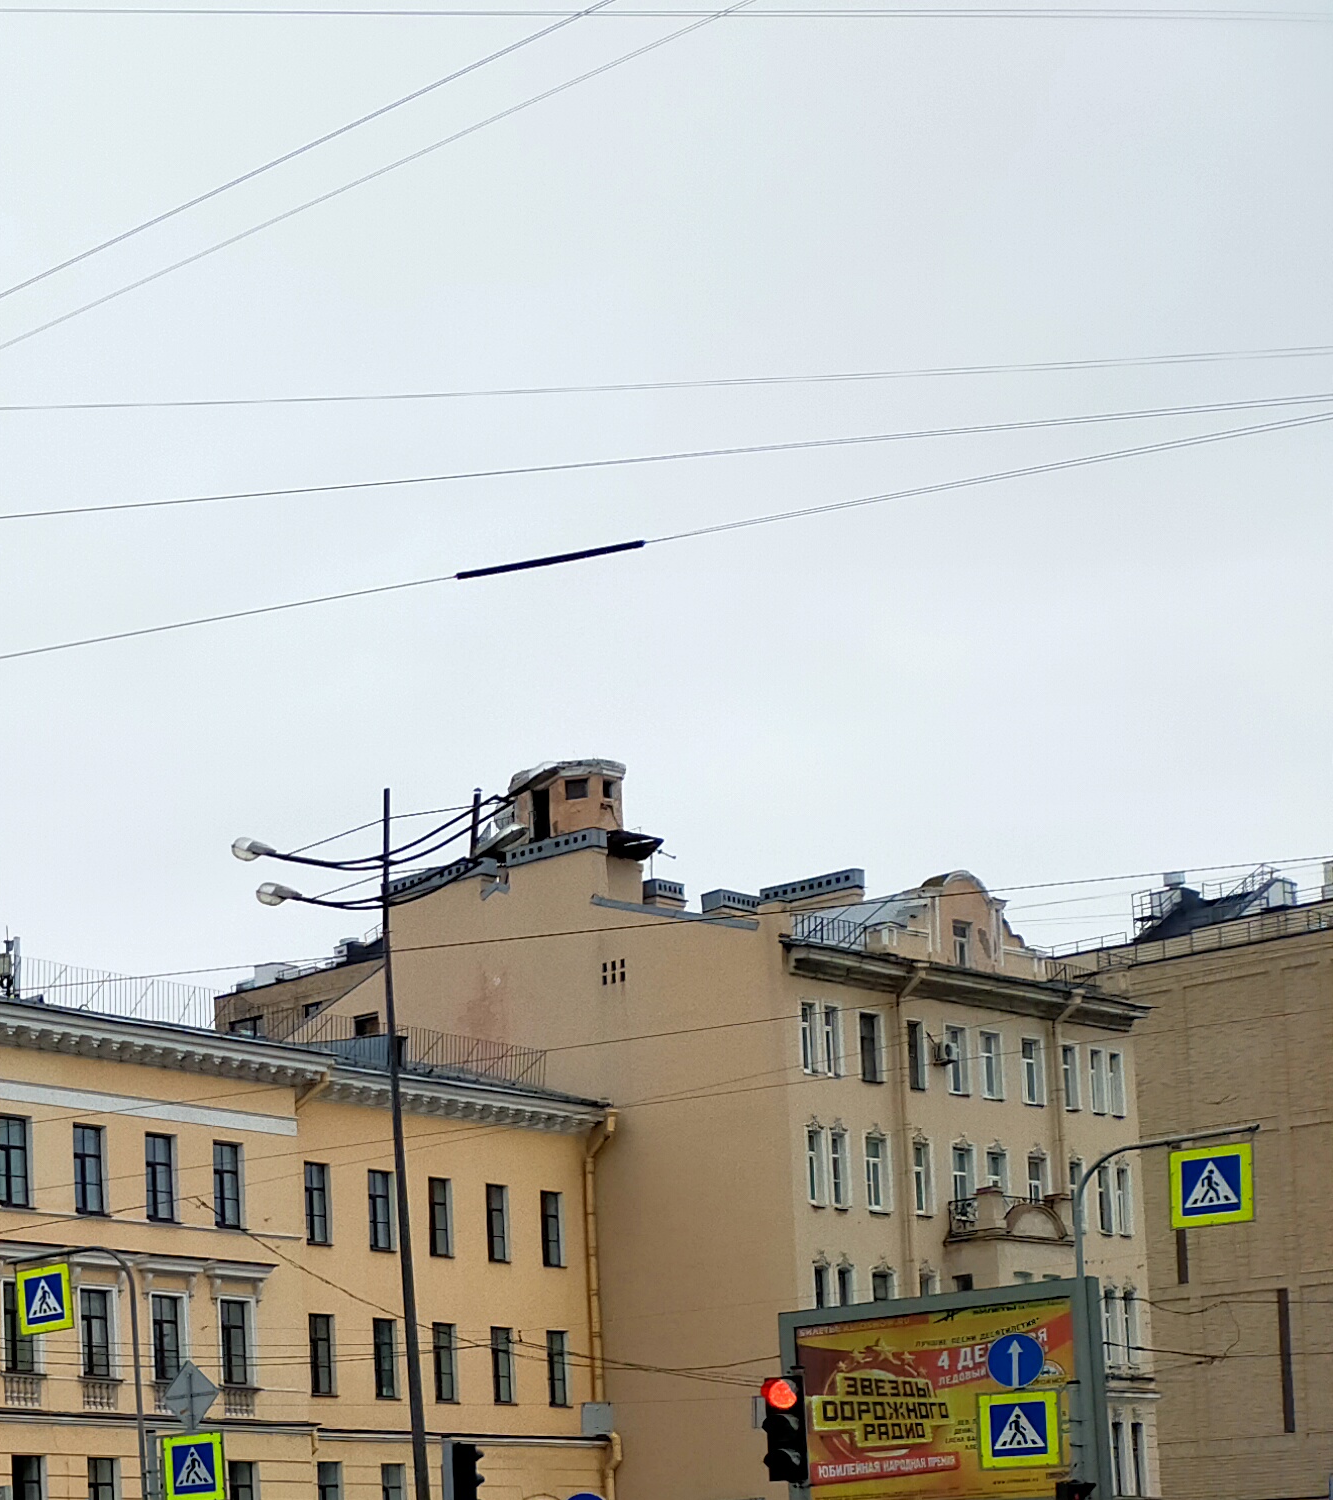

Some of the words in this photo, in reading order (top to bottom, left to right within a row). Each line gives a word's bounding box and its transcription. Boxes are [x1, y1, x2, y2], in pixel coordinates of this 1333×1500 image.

[937, 1350, 950, 1370] 4
[844, 1376, 933, 1399] ЗВЕЗДЫ
[822, 1400, 950, 1422] ДОРОЖНОГО
[864, 1421, 927, 1441] РАДИО
[818, 1461, 882, 1479] ЮБИЛЕЙНАЯ
[883, 1458, 927, 1473] НАРОДНАЯ
[928, 1455, 956, 1468] ПРЕМИЯ
